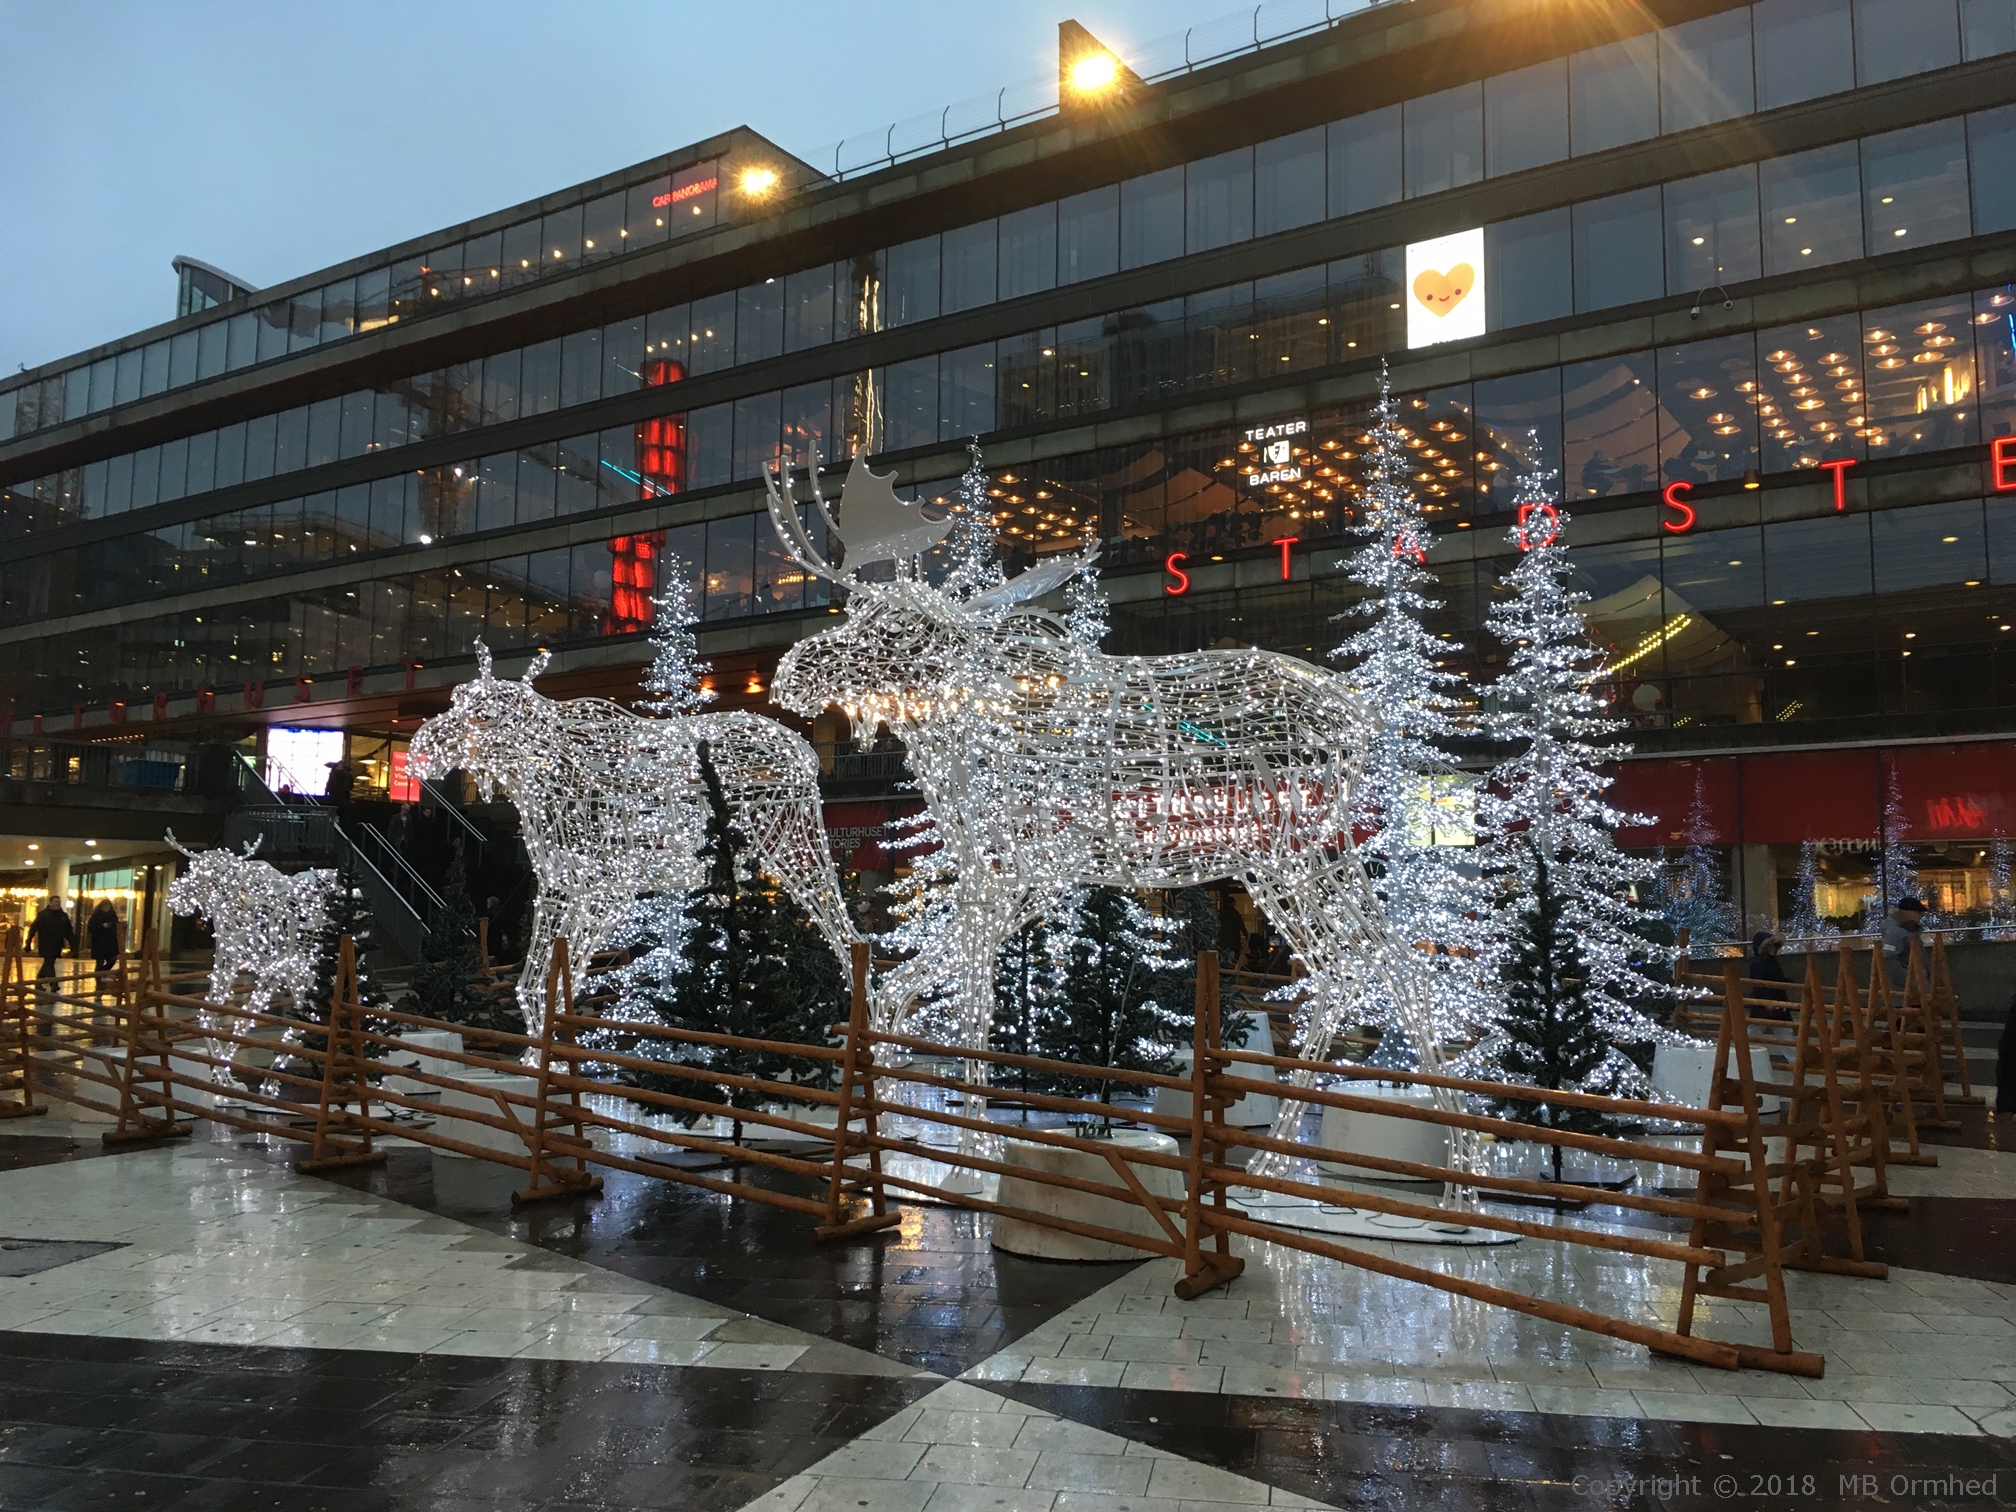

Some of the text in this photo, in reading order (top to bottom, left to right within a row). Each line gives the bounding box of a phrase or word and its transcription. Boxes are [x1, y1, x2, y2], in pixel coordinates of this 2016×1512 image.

[1244, 420, 1307, 442] TEATER
[1249, 467, 1302, 487] BAREN
[827, 837, 861, 849] TORIES
